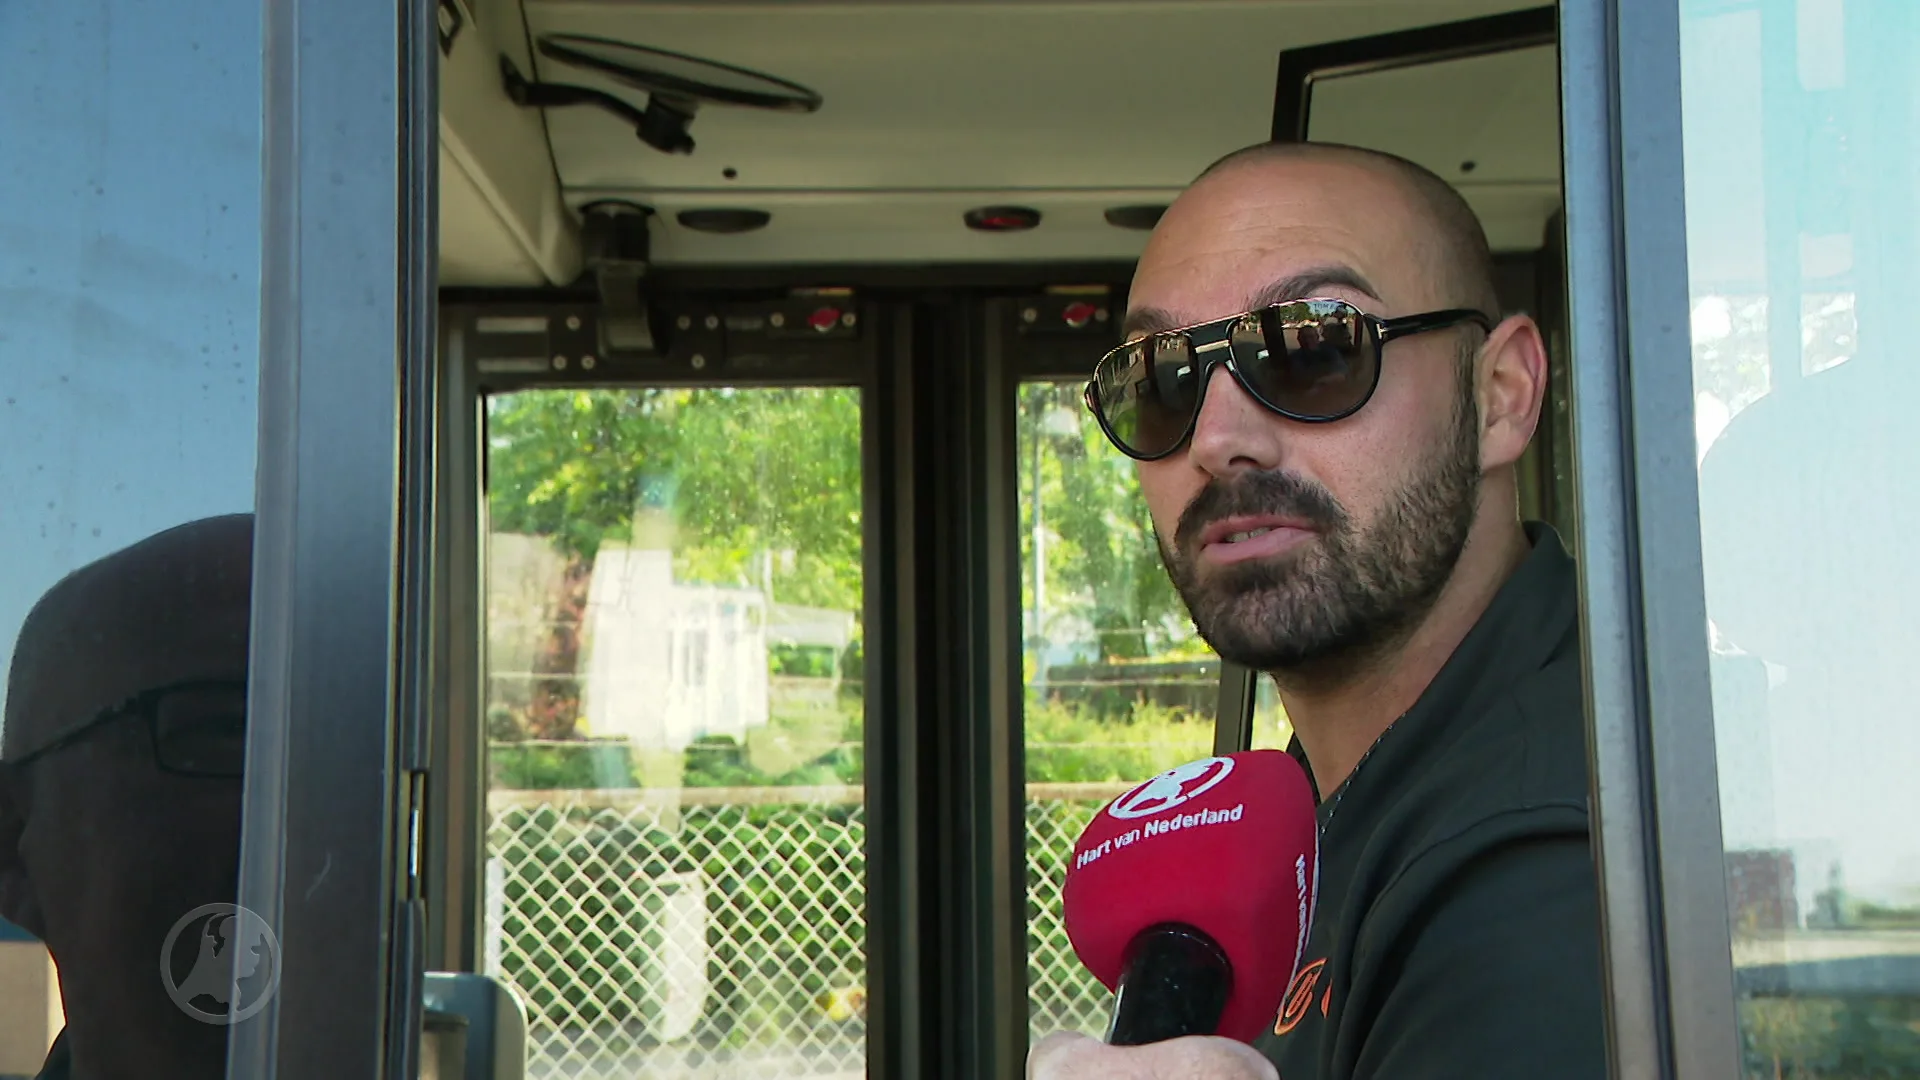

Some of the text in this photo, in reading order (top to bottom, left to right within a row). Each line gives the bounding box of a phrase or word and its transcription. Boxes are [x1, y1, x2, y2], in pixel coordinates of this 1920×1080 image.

[1076, 803, 1243, 870] Hart van Nederland
